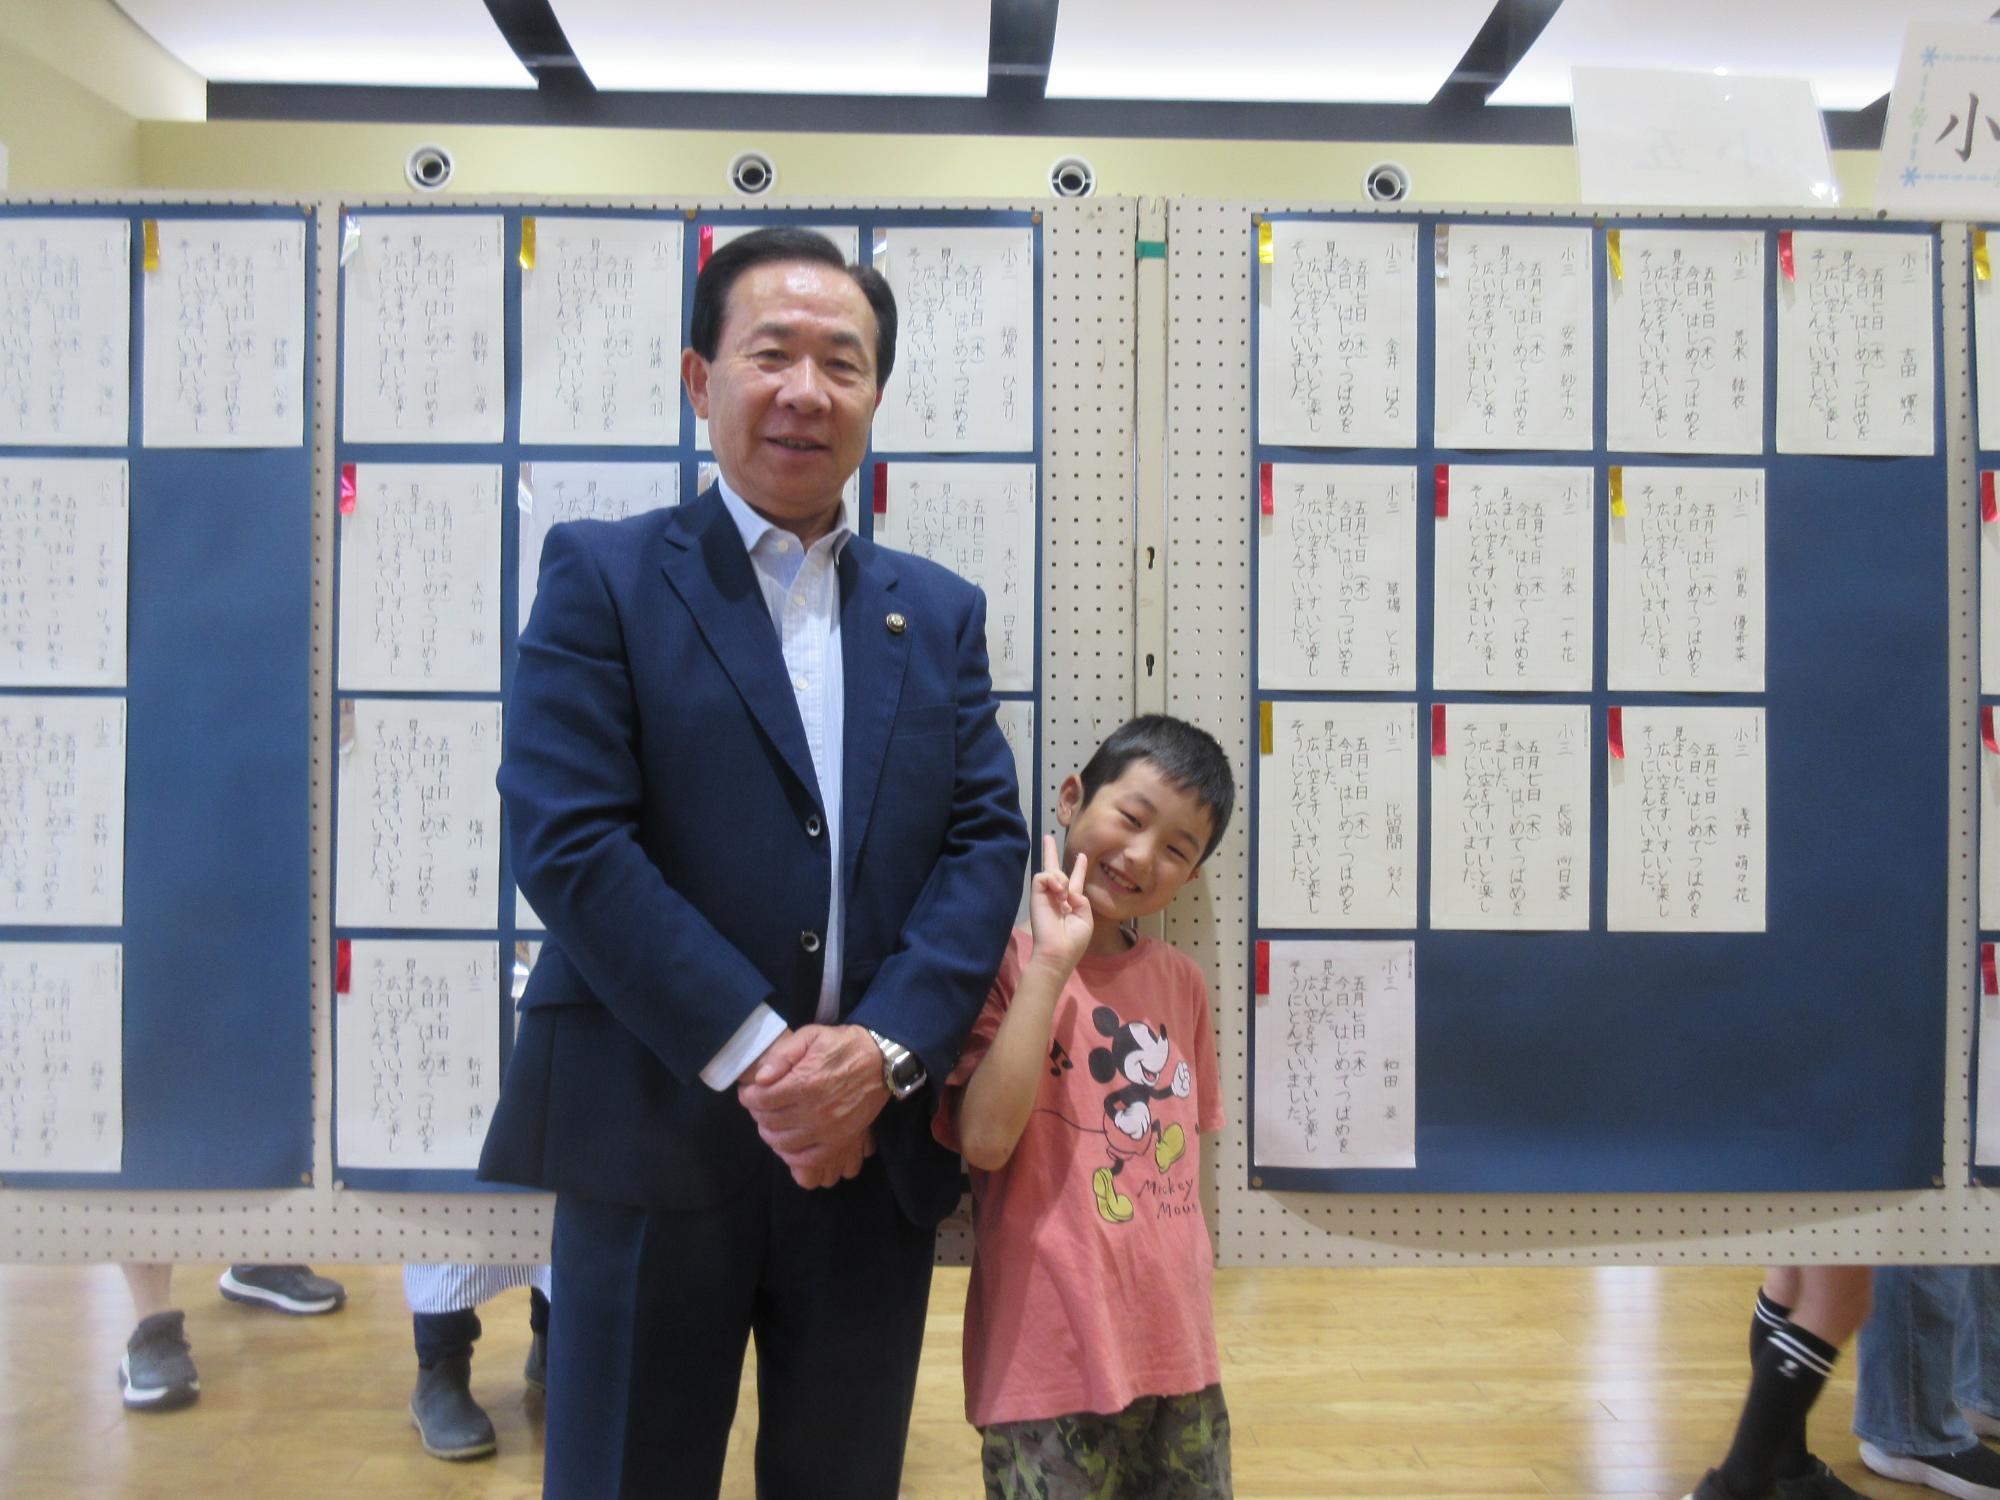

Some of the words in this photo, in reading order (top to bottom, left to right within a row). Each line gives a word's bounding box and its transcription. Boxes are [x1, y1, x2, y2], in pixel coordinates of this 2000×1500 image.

[1935, 91, 2000, 162] 小
[1001, 247, 1017, 280] 小三
[1385, 243, 1401, 273] 小三
[1561, 247, 1575, 276] 小三
[1734, 251, 1749, 279] 小三
[1901, 255, 1916, 283] 小三
[1900, 348, 1917, 377] 吉田
[1002, 375, 1017, 422] ひまり
[1385, 390, 1399, 418] はる
[1386, 485, 1400, 512] 小三
[1561, 487, 1576, 514] 小三
[1733, 488, 1748, 517] 小三
[1561, 568, 1576, 595] 河本
[1386, 631, 1399, 675] ともみ
[1560, 617, 1576, 663] 一十花
[1386, 721, 1401, 751] 小三
[1557, 724, 1574, 755] 小三
[1736, 727, 1750, 757] 小三
[1386, 803, 1402, 850] 比留間
[1735, 855, 1751, 903] 萌々花
[1383, 961, 1398, 990] 小三
[1384, 1061, 1399, 1088] 和田
[1137, 1177, 1193, 1201] Mickey
